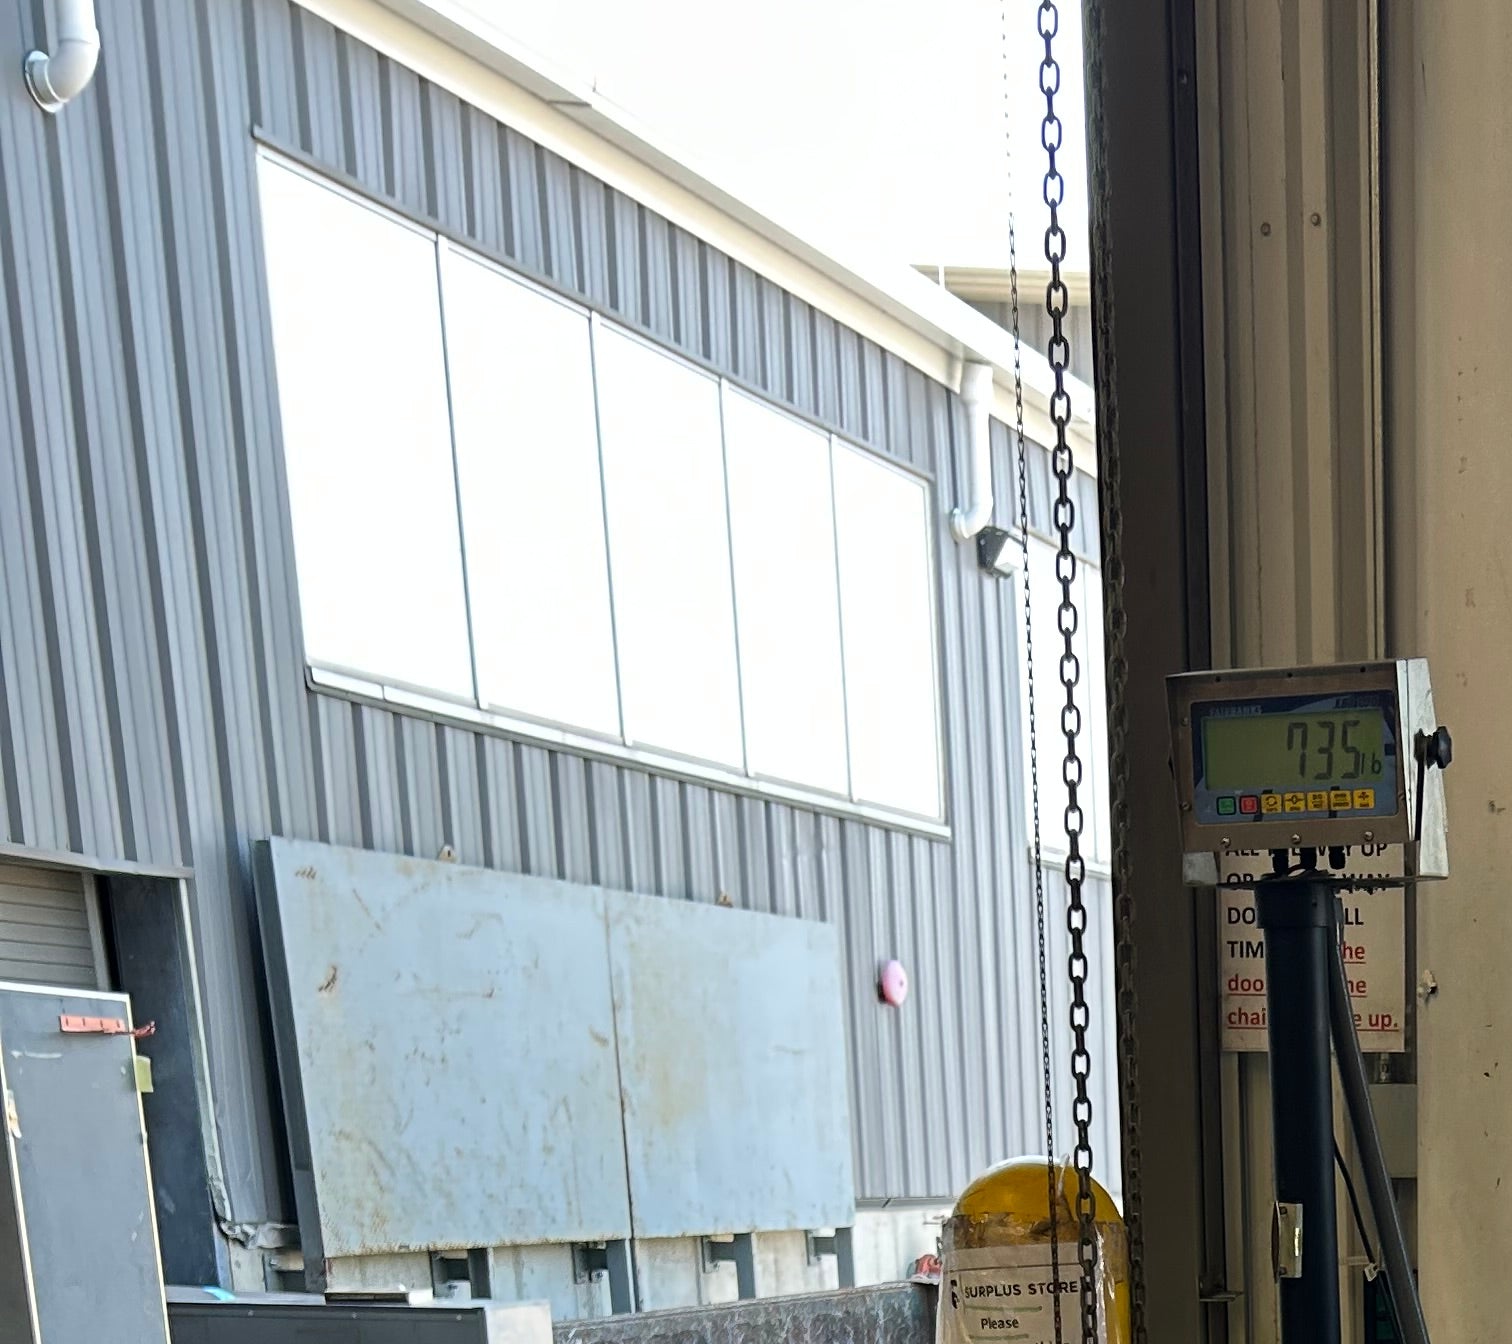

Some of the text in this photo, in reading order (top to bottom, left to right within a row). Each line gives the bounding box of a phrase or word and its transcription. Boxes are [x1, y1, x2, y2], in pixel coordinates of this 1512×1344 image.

[1287, 719, 1361, 780] 735
[1227, 907, 1364, 925] DO LL
[1226, 940, 1366, 960] TIM he
[1227, 973, 1265, 992] doo
[1227, 1007, 1267, 1026] chai
[965, 1283, 1022, 1299] SURPLUS
[980, 1317, 1020, 1330] Please
